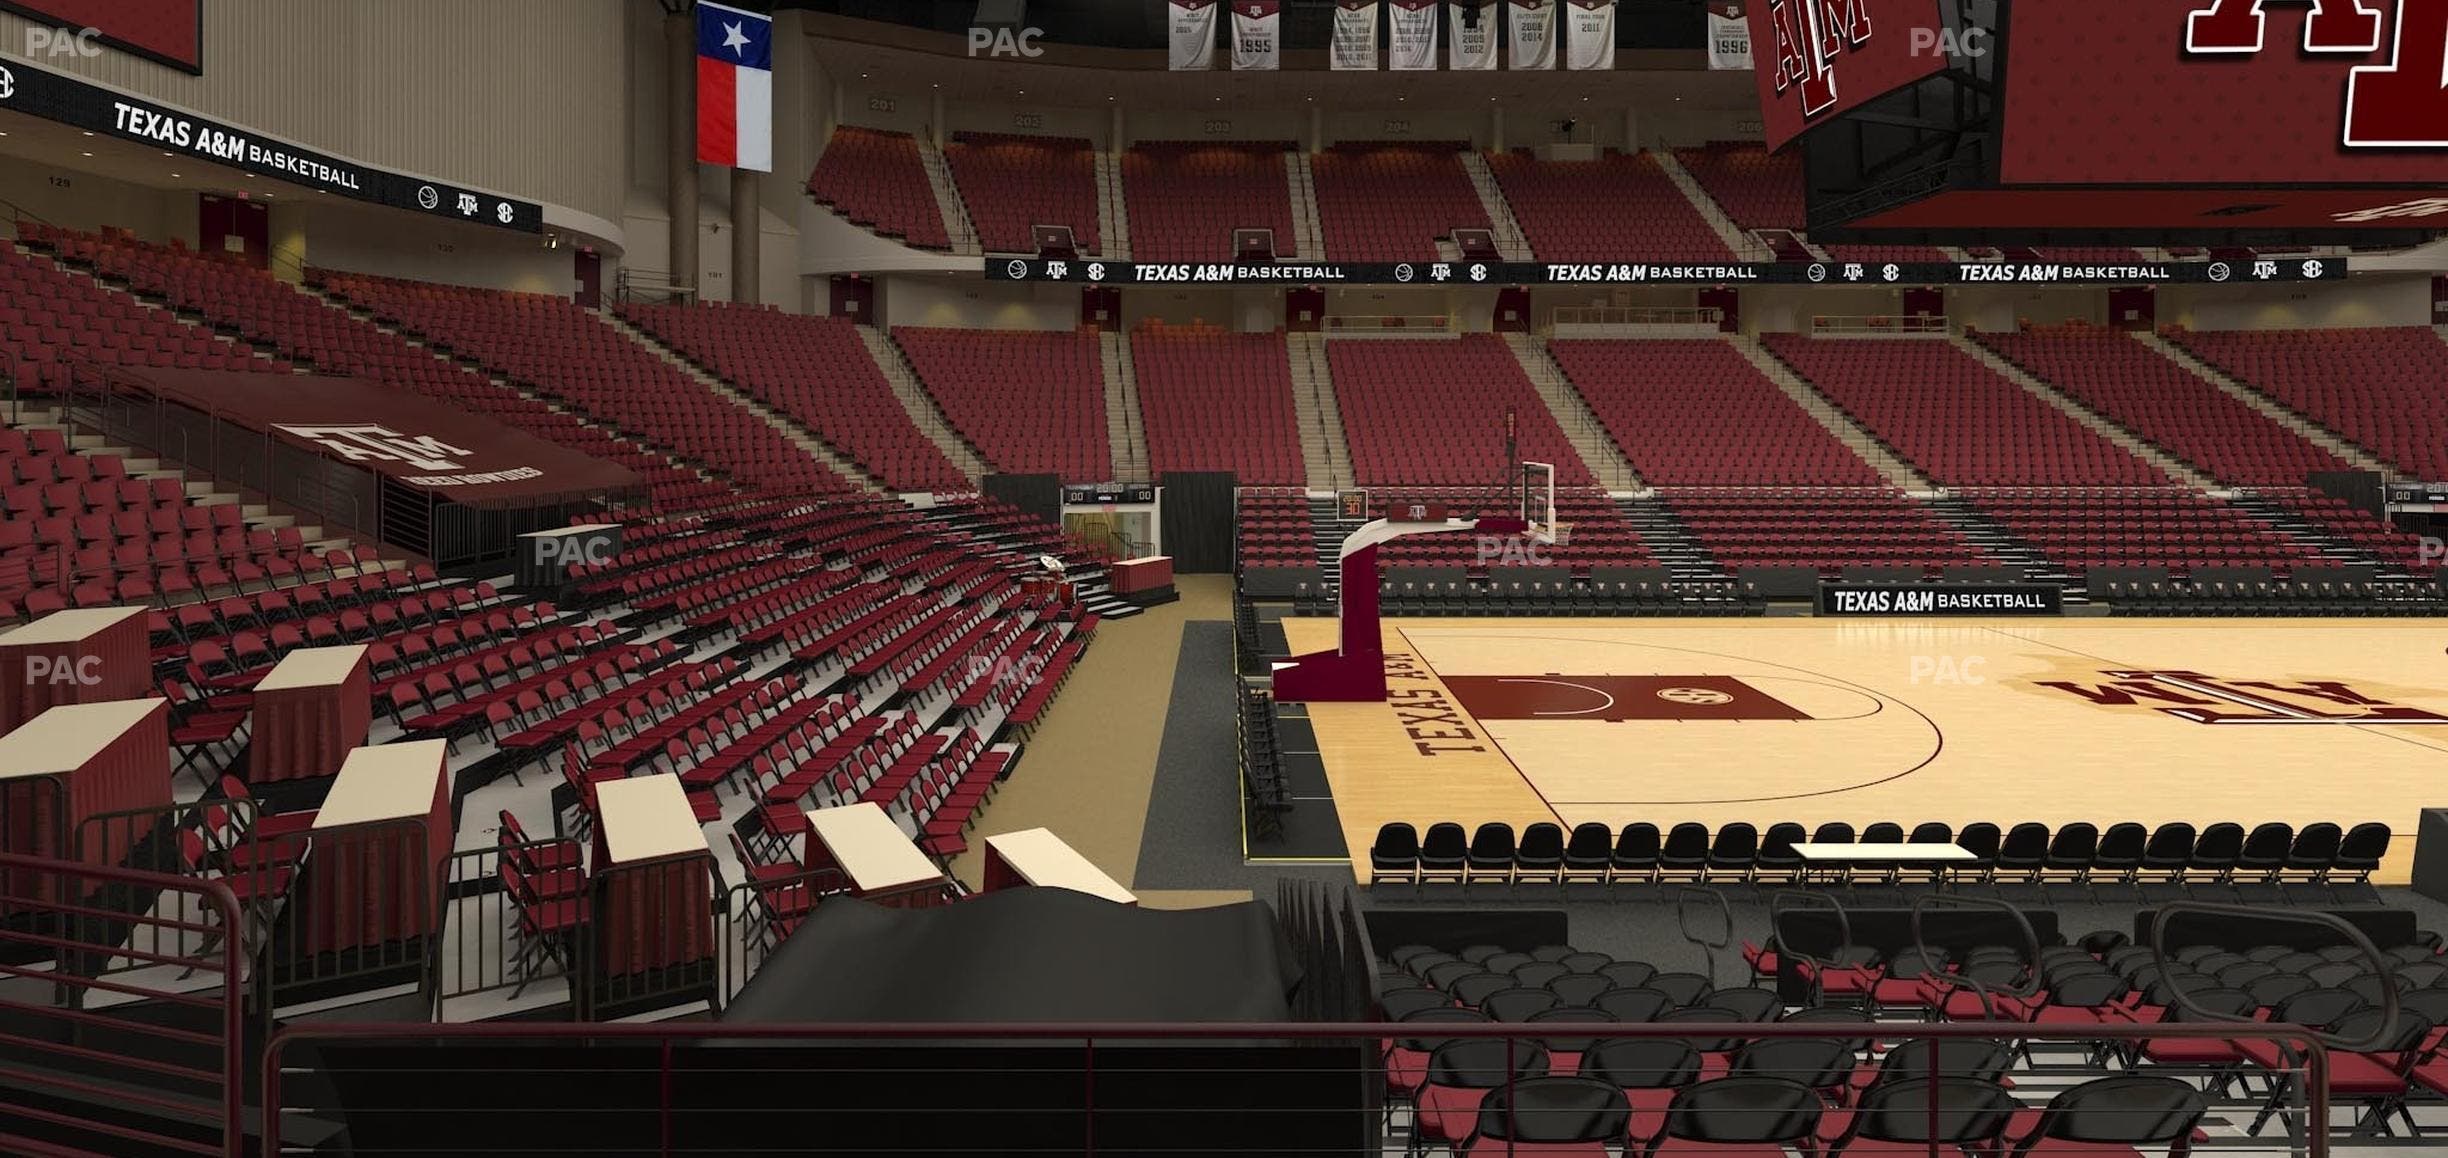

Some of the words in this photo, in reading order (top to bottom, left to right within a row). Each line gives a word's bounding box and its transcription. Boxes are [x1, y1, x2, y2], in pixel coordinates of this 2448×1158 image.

[1239, 39, 1272, 53] 1995
[1715, 40, 1748, 53] 1996
[115, 102, 191, 147] TEXAS
[195, 128, 246, 162] A&M
[249, 144, 360, 190] BASKETBALL
[1134, 265, 1190, 281] TEXAS
[1193, 265, 1234, 281] A&M
[1237, 266, 1345, 279] BASKETBALL
[1547, 265, 1603, 281] TEXAS
[1606, 265, 1647, 281] A&M
[1650, 266, 1757, 279] BASKETBALL
[1959, 265, 2015, 281] TEXAS
[2018, 265, 2059, 281] A&M
[2062, 266, 2170, 279] BASKETBALL
[1835, 591, 1890, 611] TEXAS
[1894, 591, 1934, 611] A&M
[1938, 593, 2046, 608] BASKETBALL
[1387, 689, 1486, 756] TEXAS
